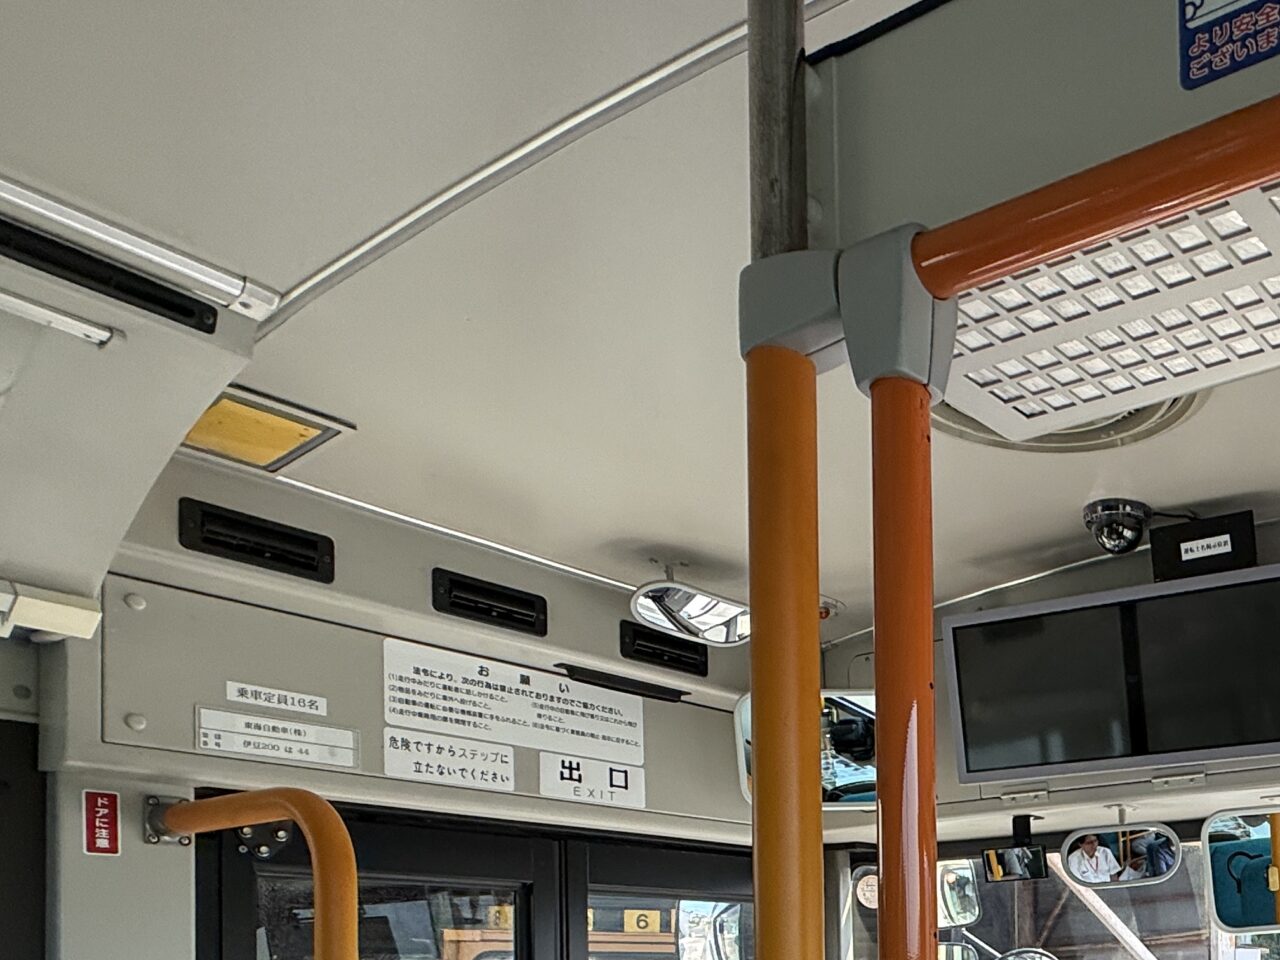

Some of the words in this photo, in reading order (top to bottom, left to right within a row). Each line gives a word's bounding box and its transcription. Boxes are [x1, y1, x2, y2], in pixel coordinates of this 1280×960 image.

[236, 687, 319, 711] 乗車定員16名
[389, 735, 509, 764] 危険ですからステップに
[413, 761, 510, 783] 立たないでください
[560, 759, 629, 790] 出口
[573, 786, 616, 801] EXIT
[636, 913, 648, 929] 6
